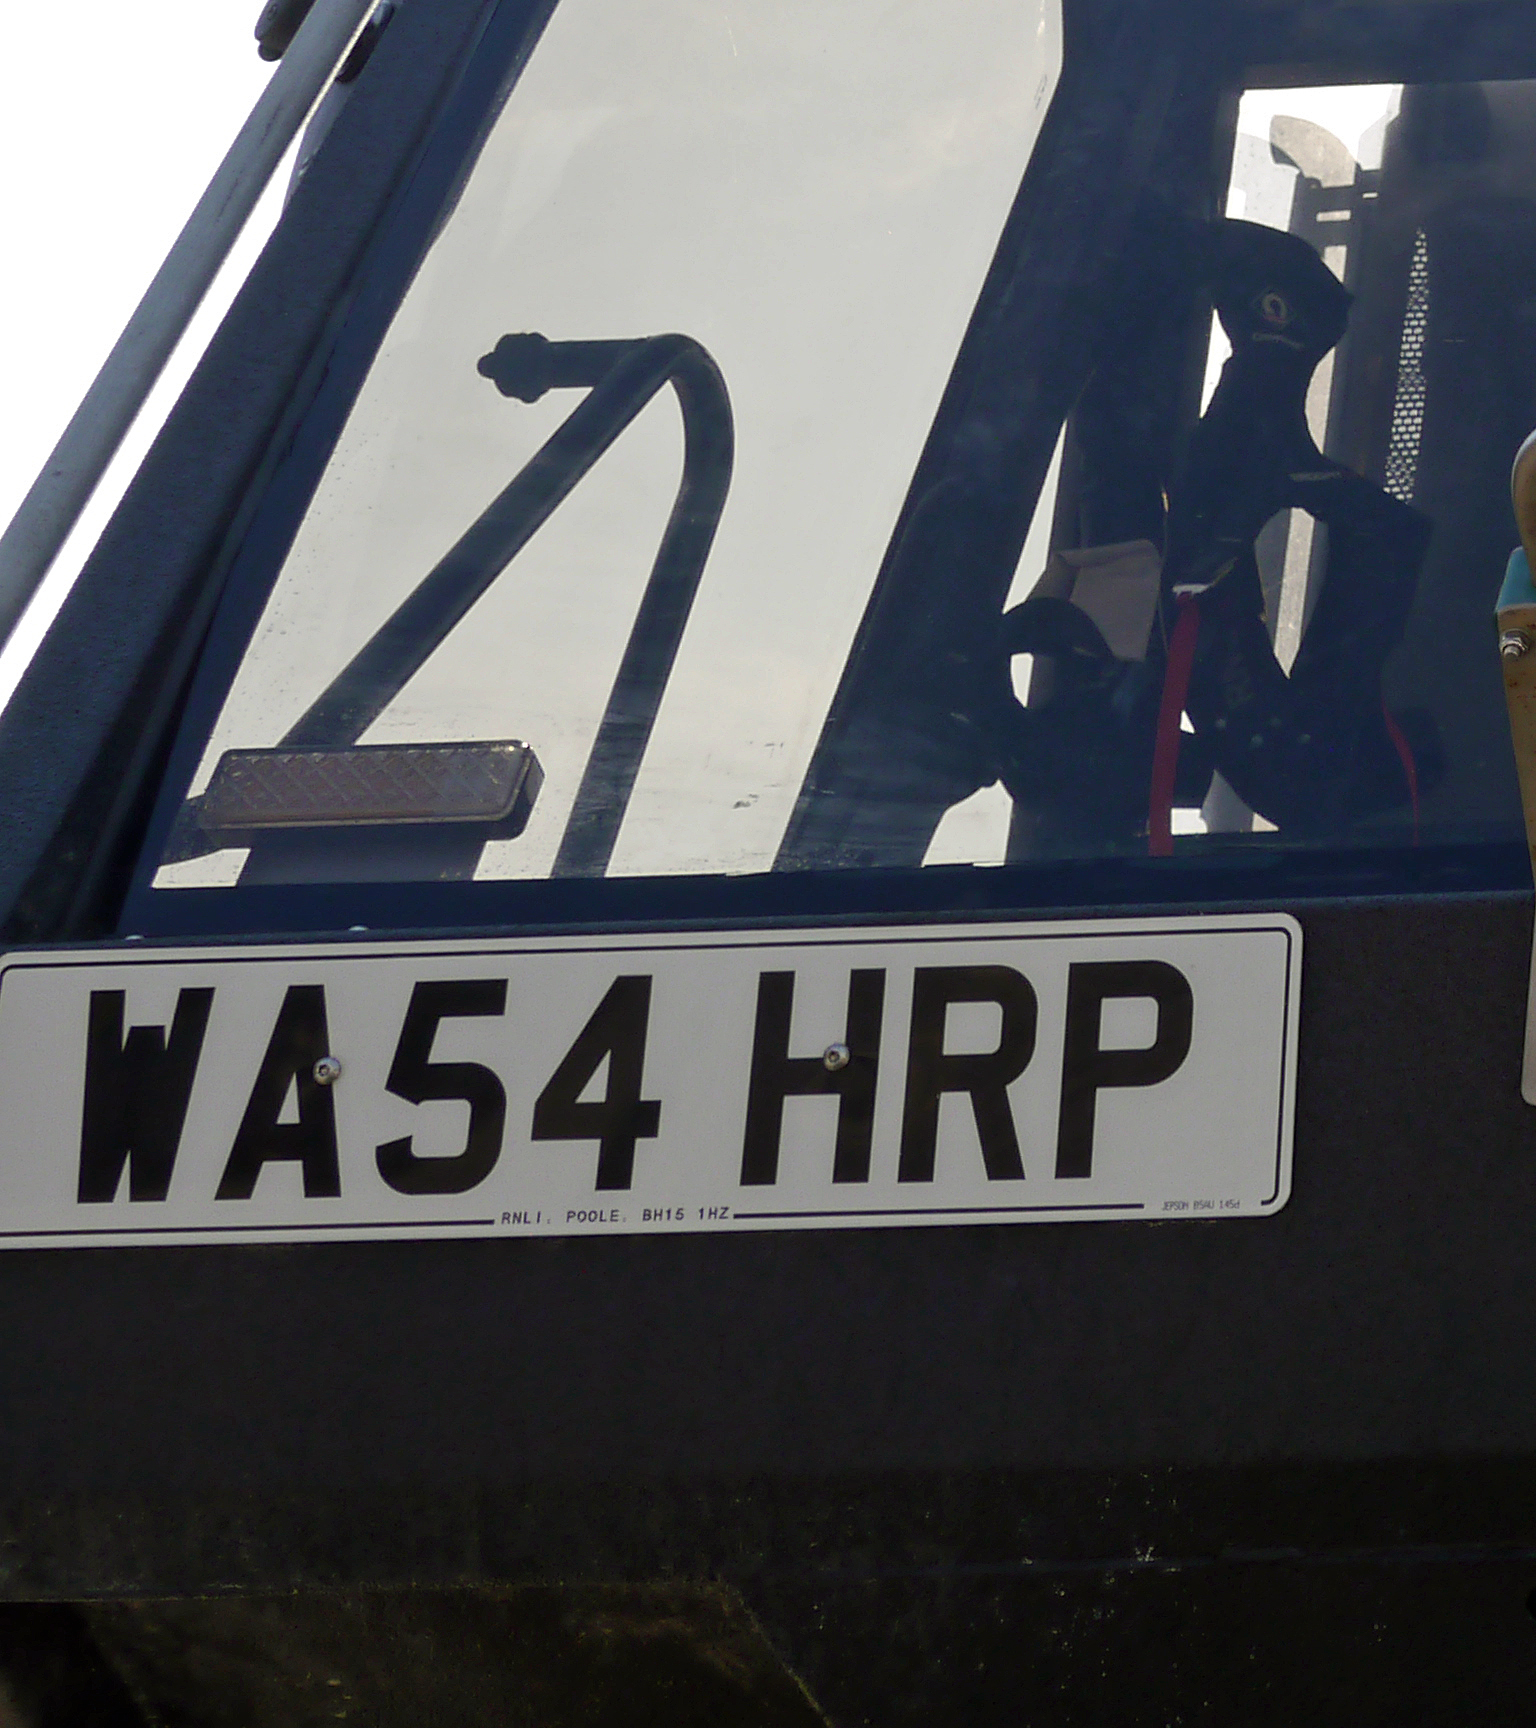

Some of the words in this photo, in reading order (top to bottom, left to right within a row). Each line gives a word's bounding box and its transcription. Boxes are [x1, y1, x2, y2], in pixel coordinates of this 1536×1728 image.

[76, 974, 662, 1205] WA54
[739, 959, 1195, 1187] HRP
[642, 1208, 685, 1222] BH15
[698, 1206, 730, 1220] 1HZ
